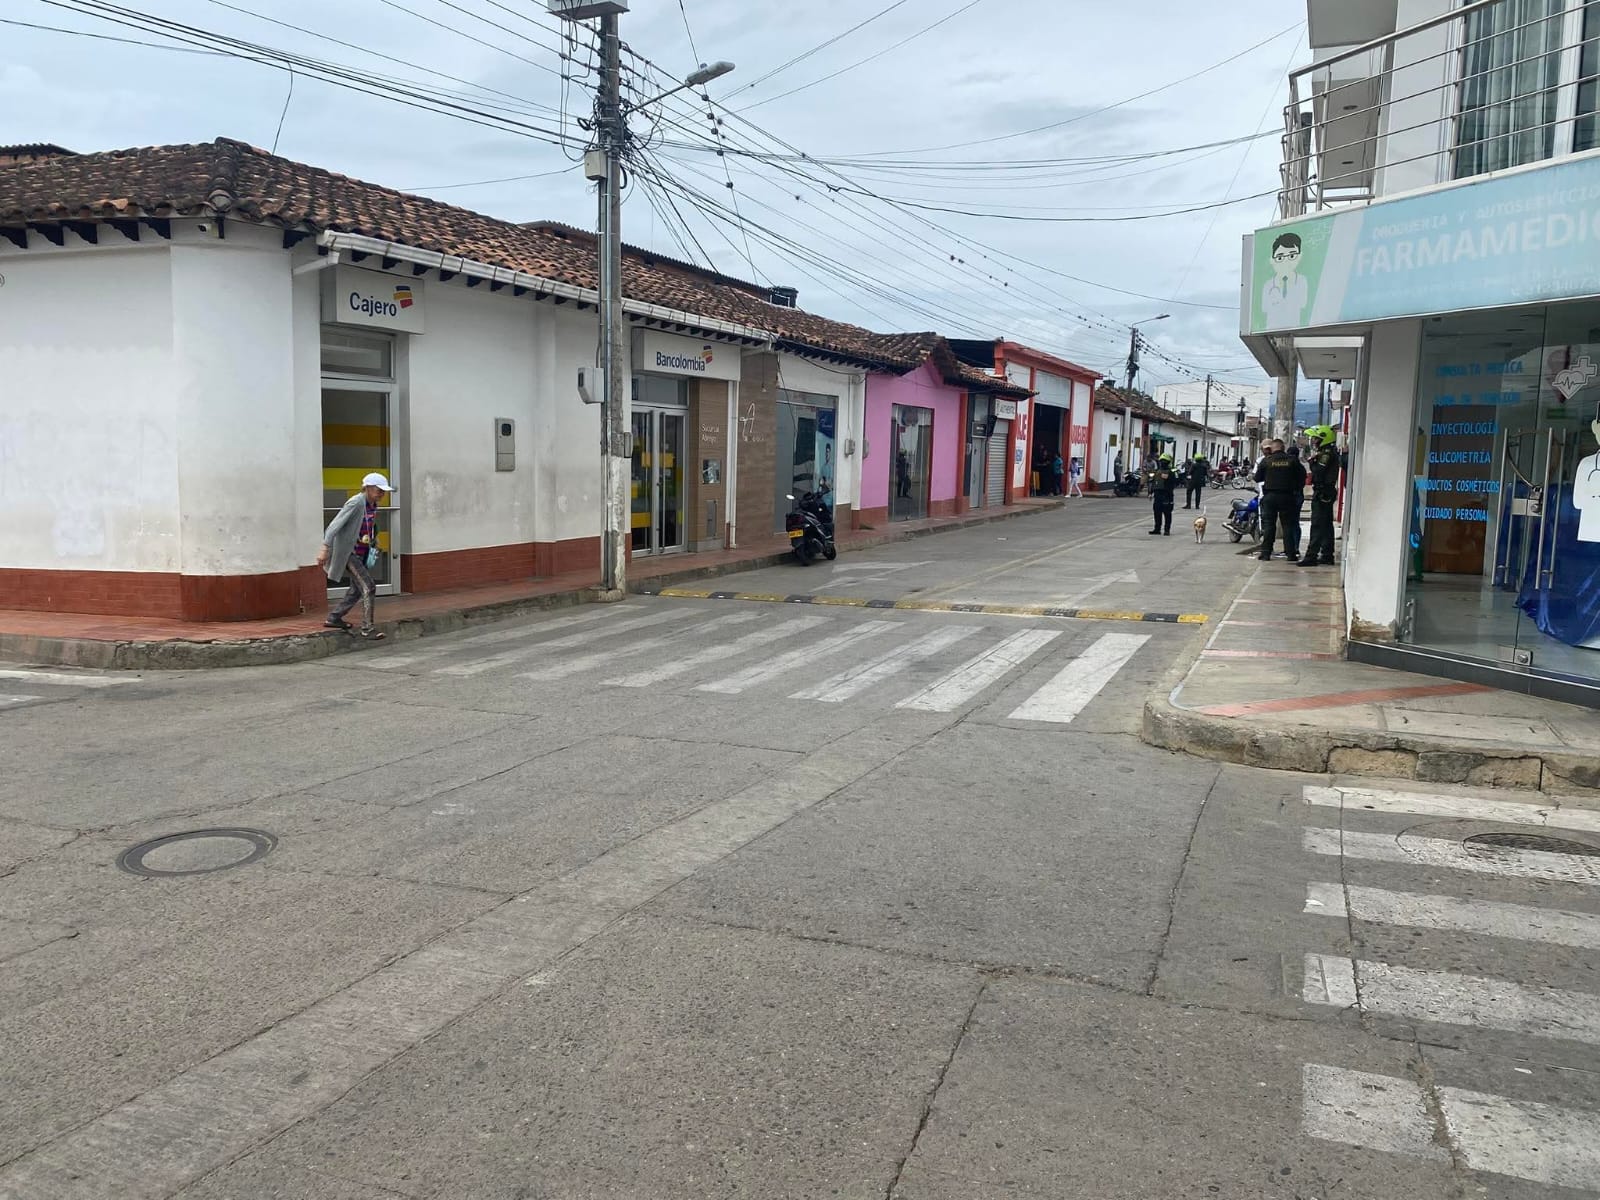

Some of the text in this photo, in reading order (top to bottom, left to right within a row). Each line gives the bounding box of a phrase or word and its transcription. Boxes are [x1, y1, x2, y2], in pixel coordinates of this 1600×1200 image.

[349, 291, 397, 317] Cajero
[656, 351, 706, 371] Bancolombia
[1428, 448, 1491, 464] GLUCOMETRÍA
[1456, 476, 1500, 493] COSMÉTICOS
[1424, 506, 1453, 520] CUIDADO
